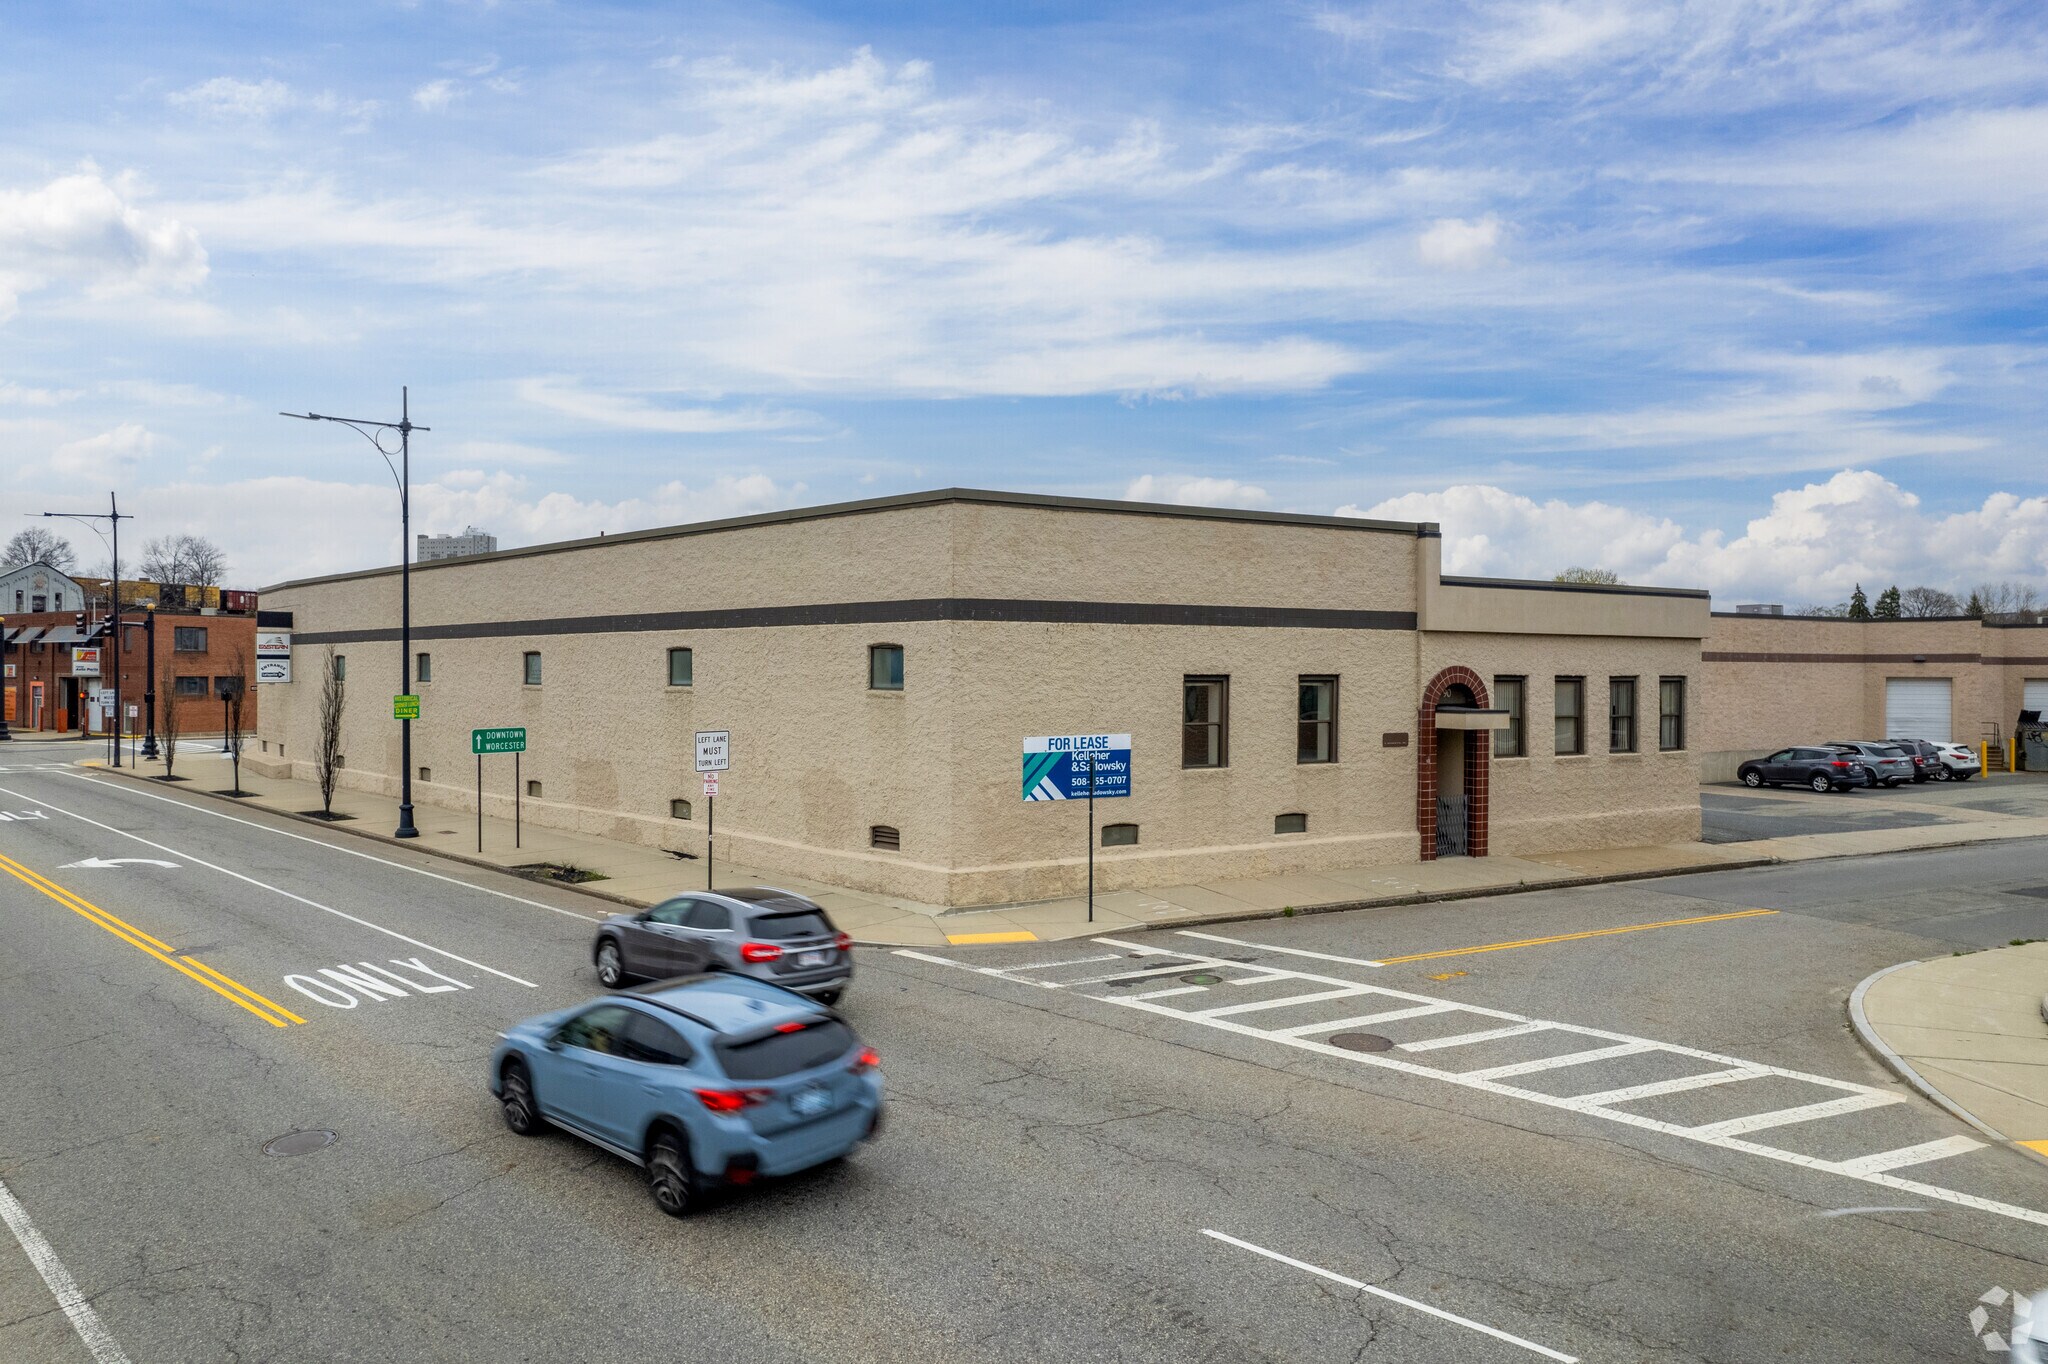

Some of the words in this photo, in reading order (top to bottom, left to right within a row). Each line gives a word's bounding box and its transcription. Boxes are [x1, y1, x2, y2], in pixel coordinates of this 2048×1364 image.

[261, 663, 286, 671] ENTRANCE
[486, 731, 524, 739] DOWNTOWN
[698, 736, 711, 744] LEFT
[713, 735, 727, 743] LANE
[485, 741, 525, 750] WORCESTER
[1048, 738, 1070, 751] FOR
[1073, 736, 1109, 750] LEASE
[703, 747, 722, 755] MUST
[698, 759, 712, 767] TURN
[714, 758, 727, 766] LEFT
[1071, 761, 1126, 772] &Saowsky
[1071, 776, 1127, 786] 508-55-0707
[1071, 789, 1127, 797] kelleheadowsky.com
[283, 957, 474, 1009] ONLY
